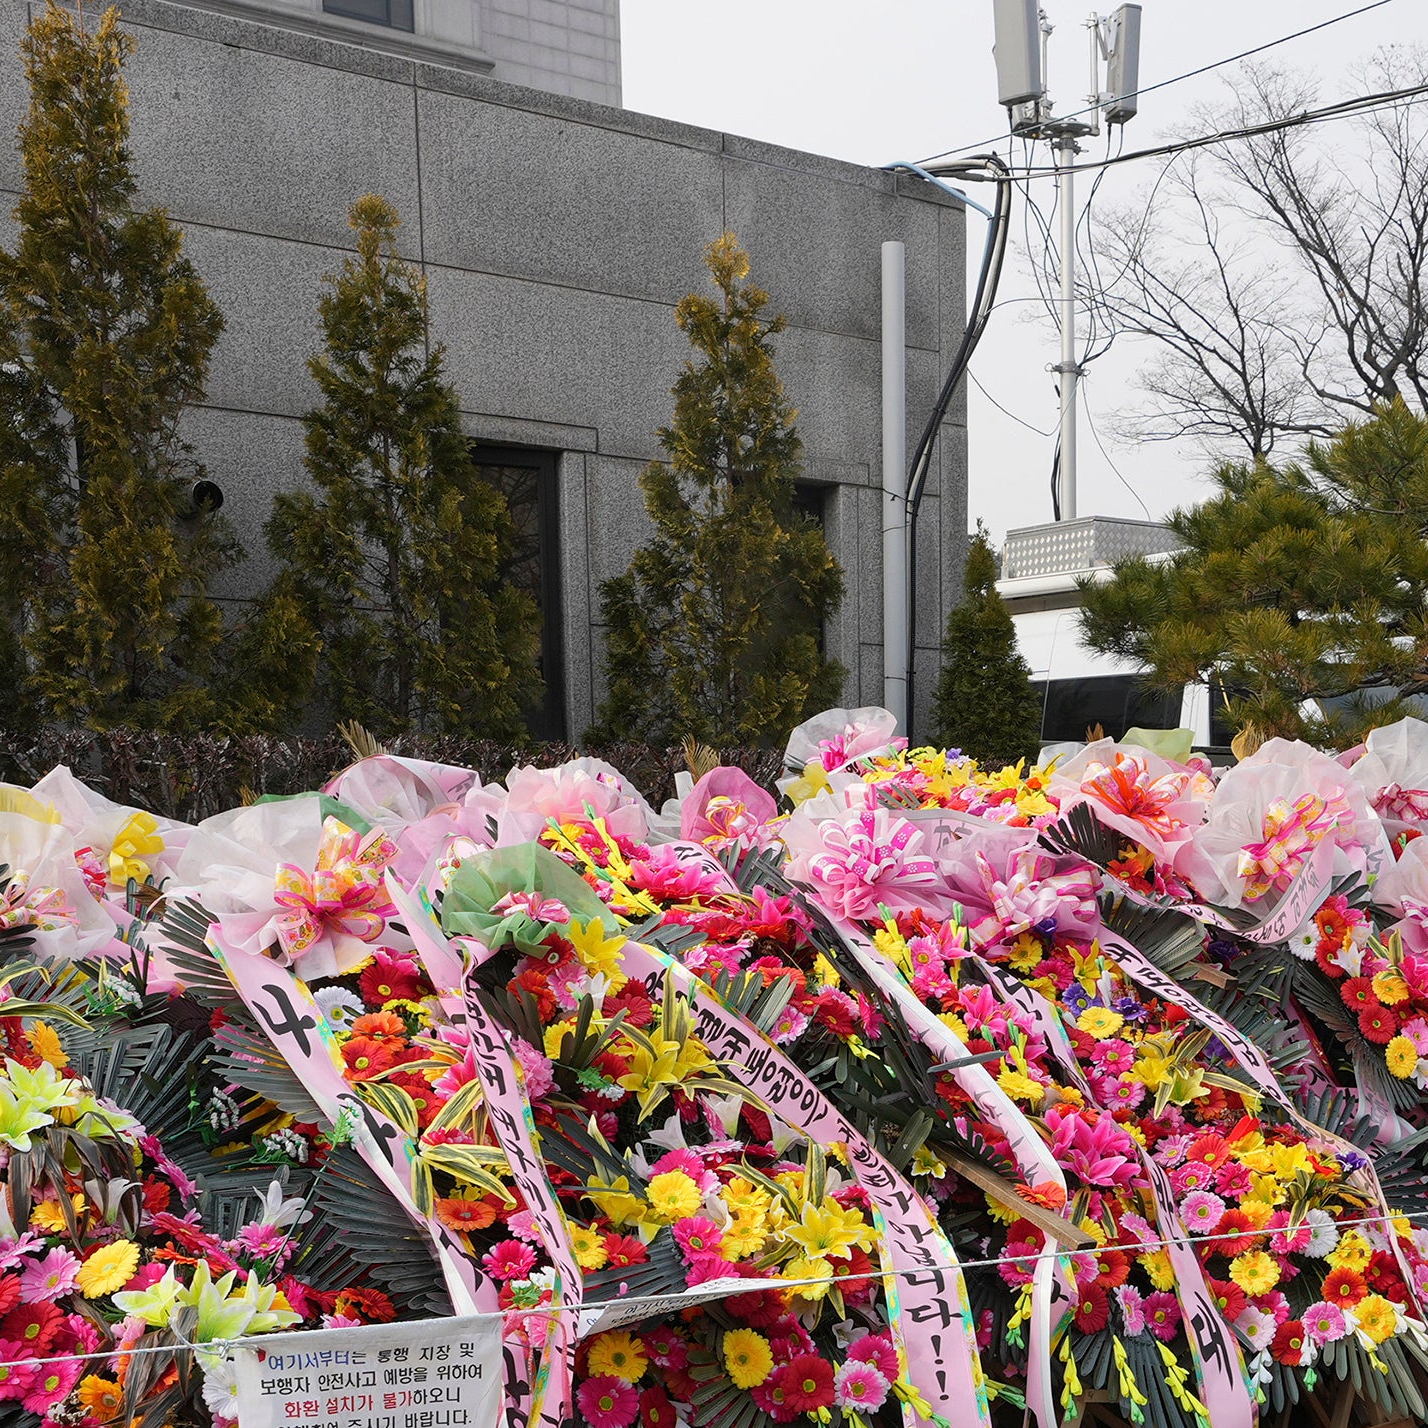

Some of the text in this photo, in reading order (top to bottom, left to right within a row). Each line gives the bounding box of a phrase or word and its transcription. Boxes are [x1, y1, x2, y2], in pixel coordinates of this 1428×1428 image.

[644, 966, 830, 1128] 윤열대통령은
[268, 1342, 475, 1371] 여기서부터는 통행 지장 및
[260, 1363, 483, 1396] 보행자 안전사고 예방을 위하여
[284, 1387, 461, 1419] 화환 설치가 불가하오니
